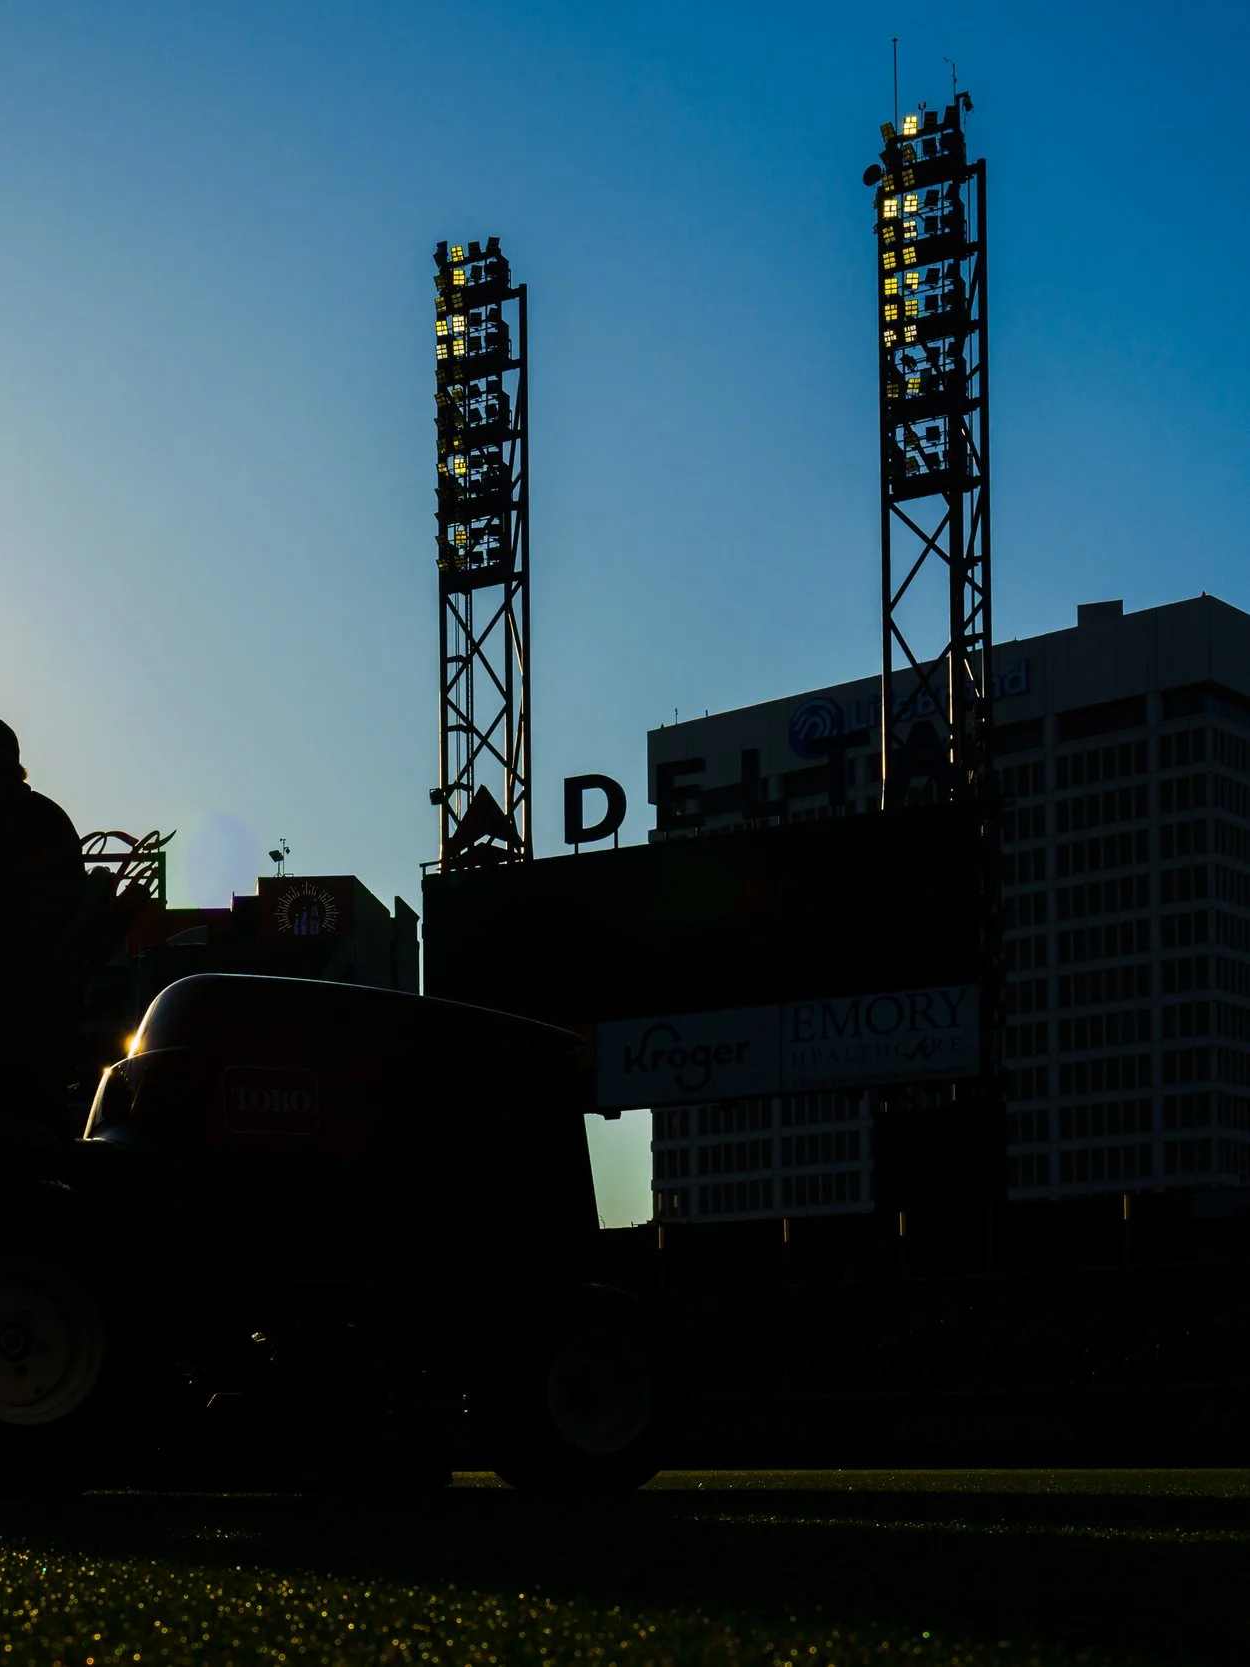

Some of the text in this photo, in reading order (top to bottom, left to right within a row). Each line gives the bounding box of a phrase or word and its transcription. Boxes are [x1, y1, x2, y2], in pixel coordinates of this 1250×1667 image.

[565, 719, 962, 844] DELTA
[790, 986, 968, 1044] EMORY
[623, 1021, 751, 1093] Kroger
[792, 1036, 962, 1067] HEALTHCARE
[230, 1085, 312, 1114] TORO
